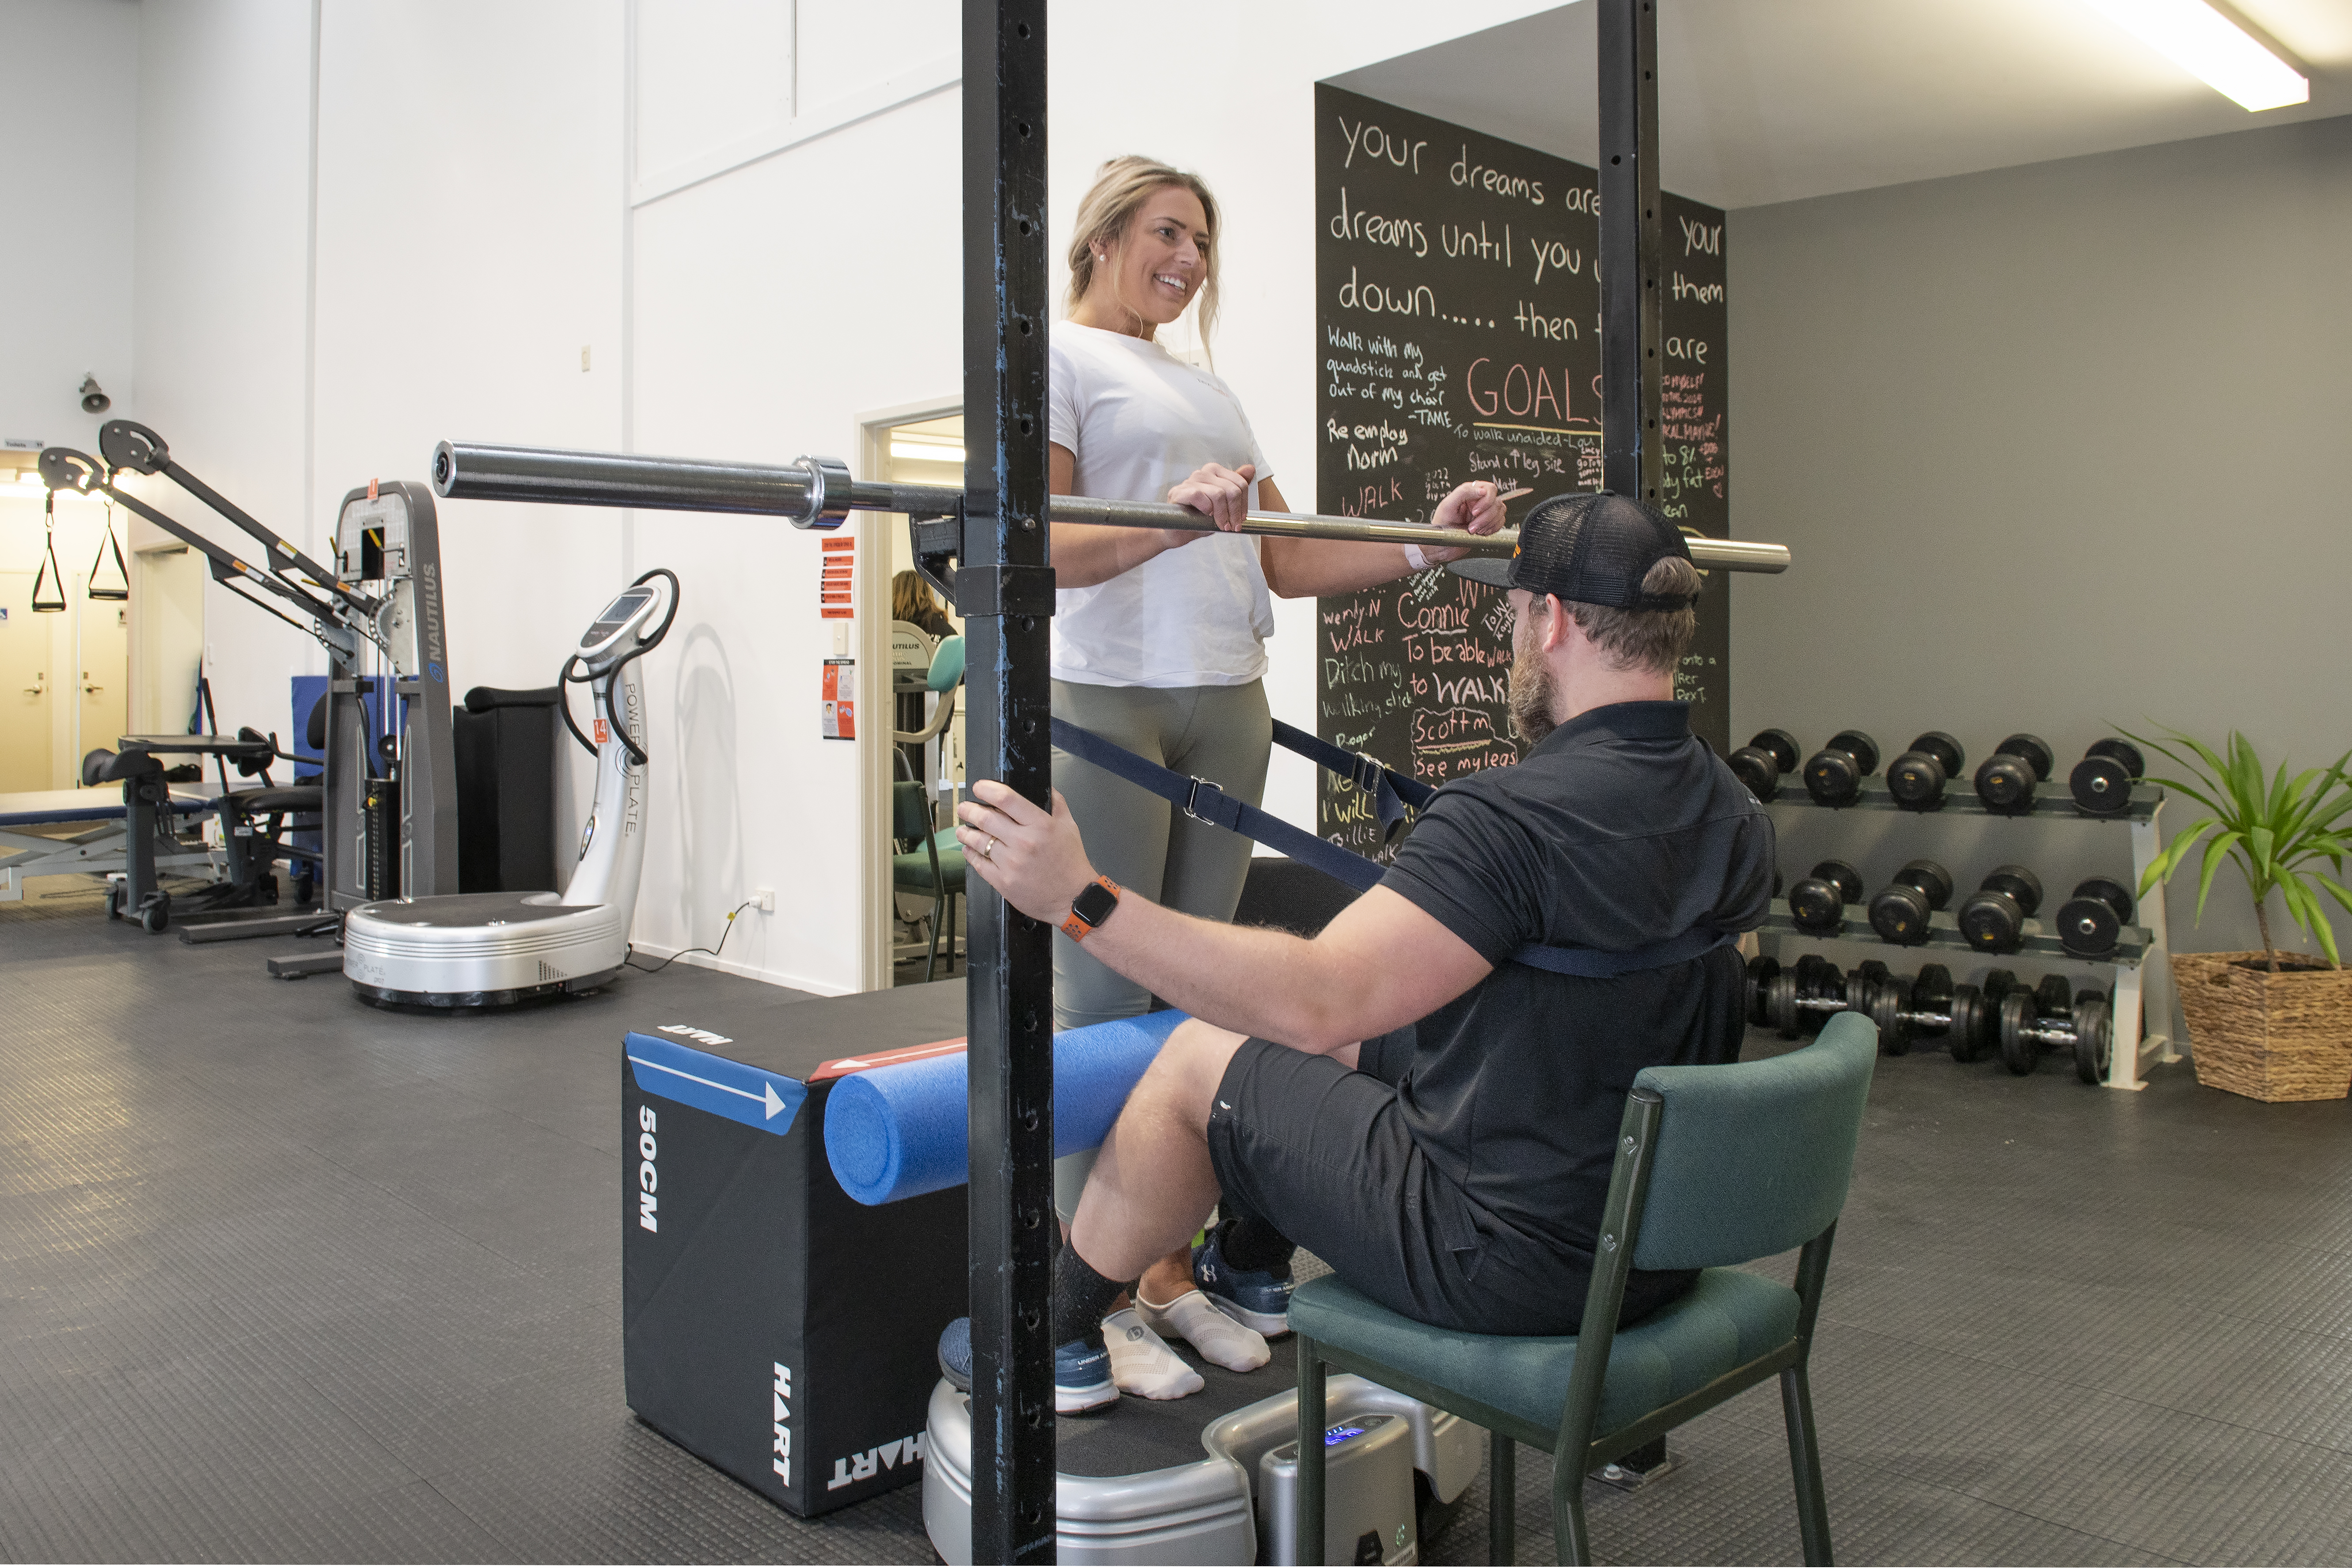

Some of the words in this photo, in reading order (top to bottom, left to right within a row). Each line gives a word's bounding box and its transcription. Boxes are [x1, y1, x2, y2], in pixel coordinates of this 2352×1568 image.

[1339, 116, 1427, 174] your
[1450, 144, 1545, 205] dreams
[1565, 187, 1601, 217] are
[1679, 215, 1722, 256] your
[1330, 187, 1428, 258] dreams
[1442, 220, 1511, 268] until
[1531, 238, 1581, 285] you
[1672, 271, 1723, 303] them
[1328, 325, 1364, 352] Walk
[1368, 335, 1398, 358] with
[1514, 300, 1578, 341] then
[1666, 337, 1708, 365] are
[1327, 357, 1393, 384] quadstick
[1402, 363, 1423, 380] and
[1428, 365, 1448, 391] get
[1361, 382, 1377, 399] of
[1382, 387, 1403, 409] my
[1410, 389, 1445, 405] chair
[1354, 418, 1408, 446] employ
[1453, 423, 1469, 439] To
[1473, 428, 1504, 442] walk
[1469, 451, 1501, 473] Stand
[1523, 452, 1540, 478] leg
[1662, 444, 1677, 466] to
[1492, 474, 1518, 492] Matt
[1683, 465, 1704, 489] fat
[1342, 477, 1404, 517] WALK
[423, 563, 441, 661] NAUTILUS
[1397, 591, 1470, 629] Connie
[1330, 624, 1385, 653] WALK
[1402, 633, 1424, 663] To
[1431, 636, 1454, 665] be
[1457, 636, 1486, 665] able
[1325, 651, 1375, 690] Ditch
[1379, 661, 1402, 689] my
[1410, 672, 1428, 696] to
[595, 720, 606, 735] 14
[626, 683, 640, 747] POWER
[1336, 726, 1376, 749] Roger
[1416, 757, 1448, 777] See
[1458, 758, 1480, 773] my
[656, 1024, 734, 1045] HART
[639, 1104, 658, 1234] 50CM
[774, 1361, 791, 1488] HART
[827, 1431, 927, 1491] HART
